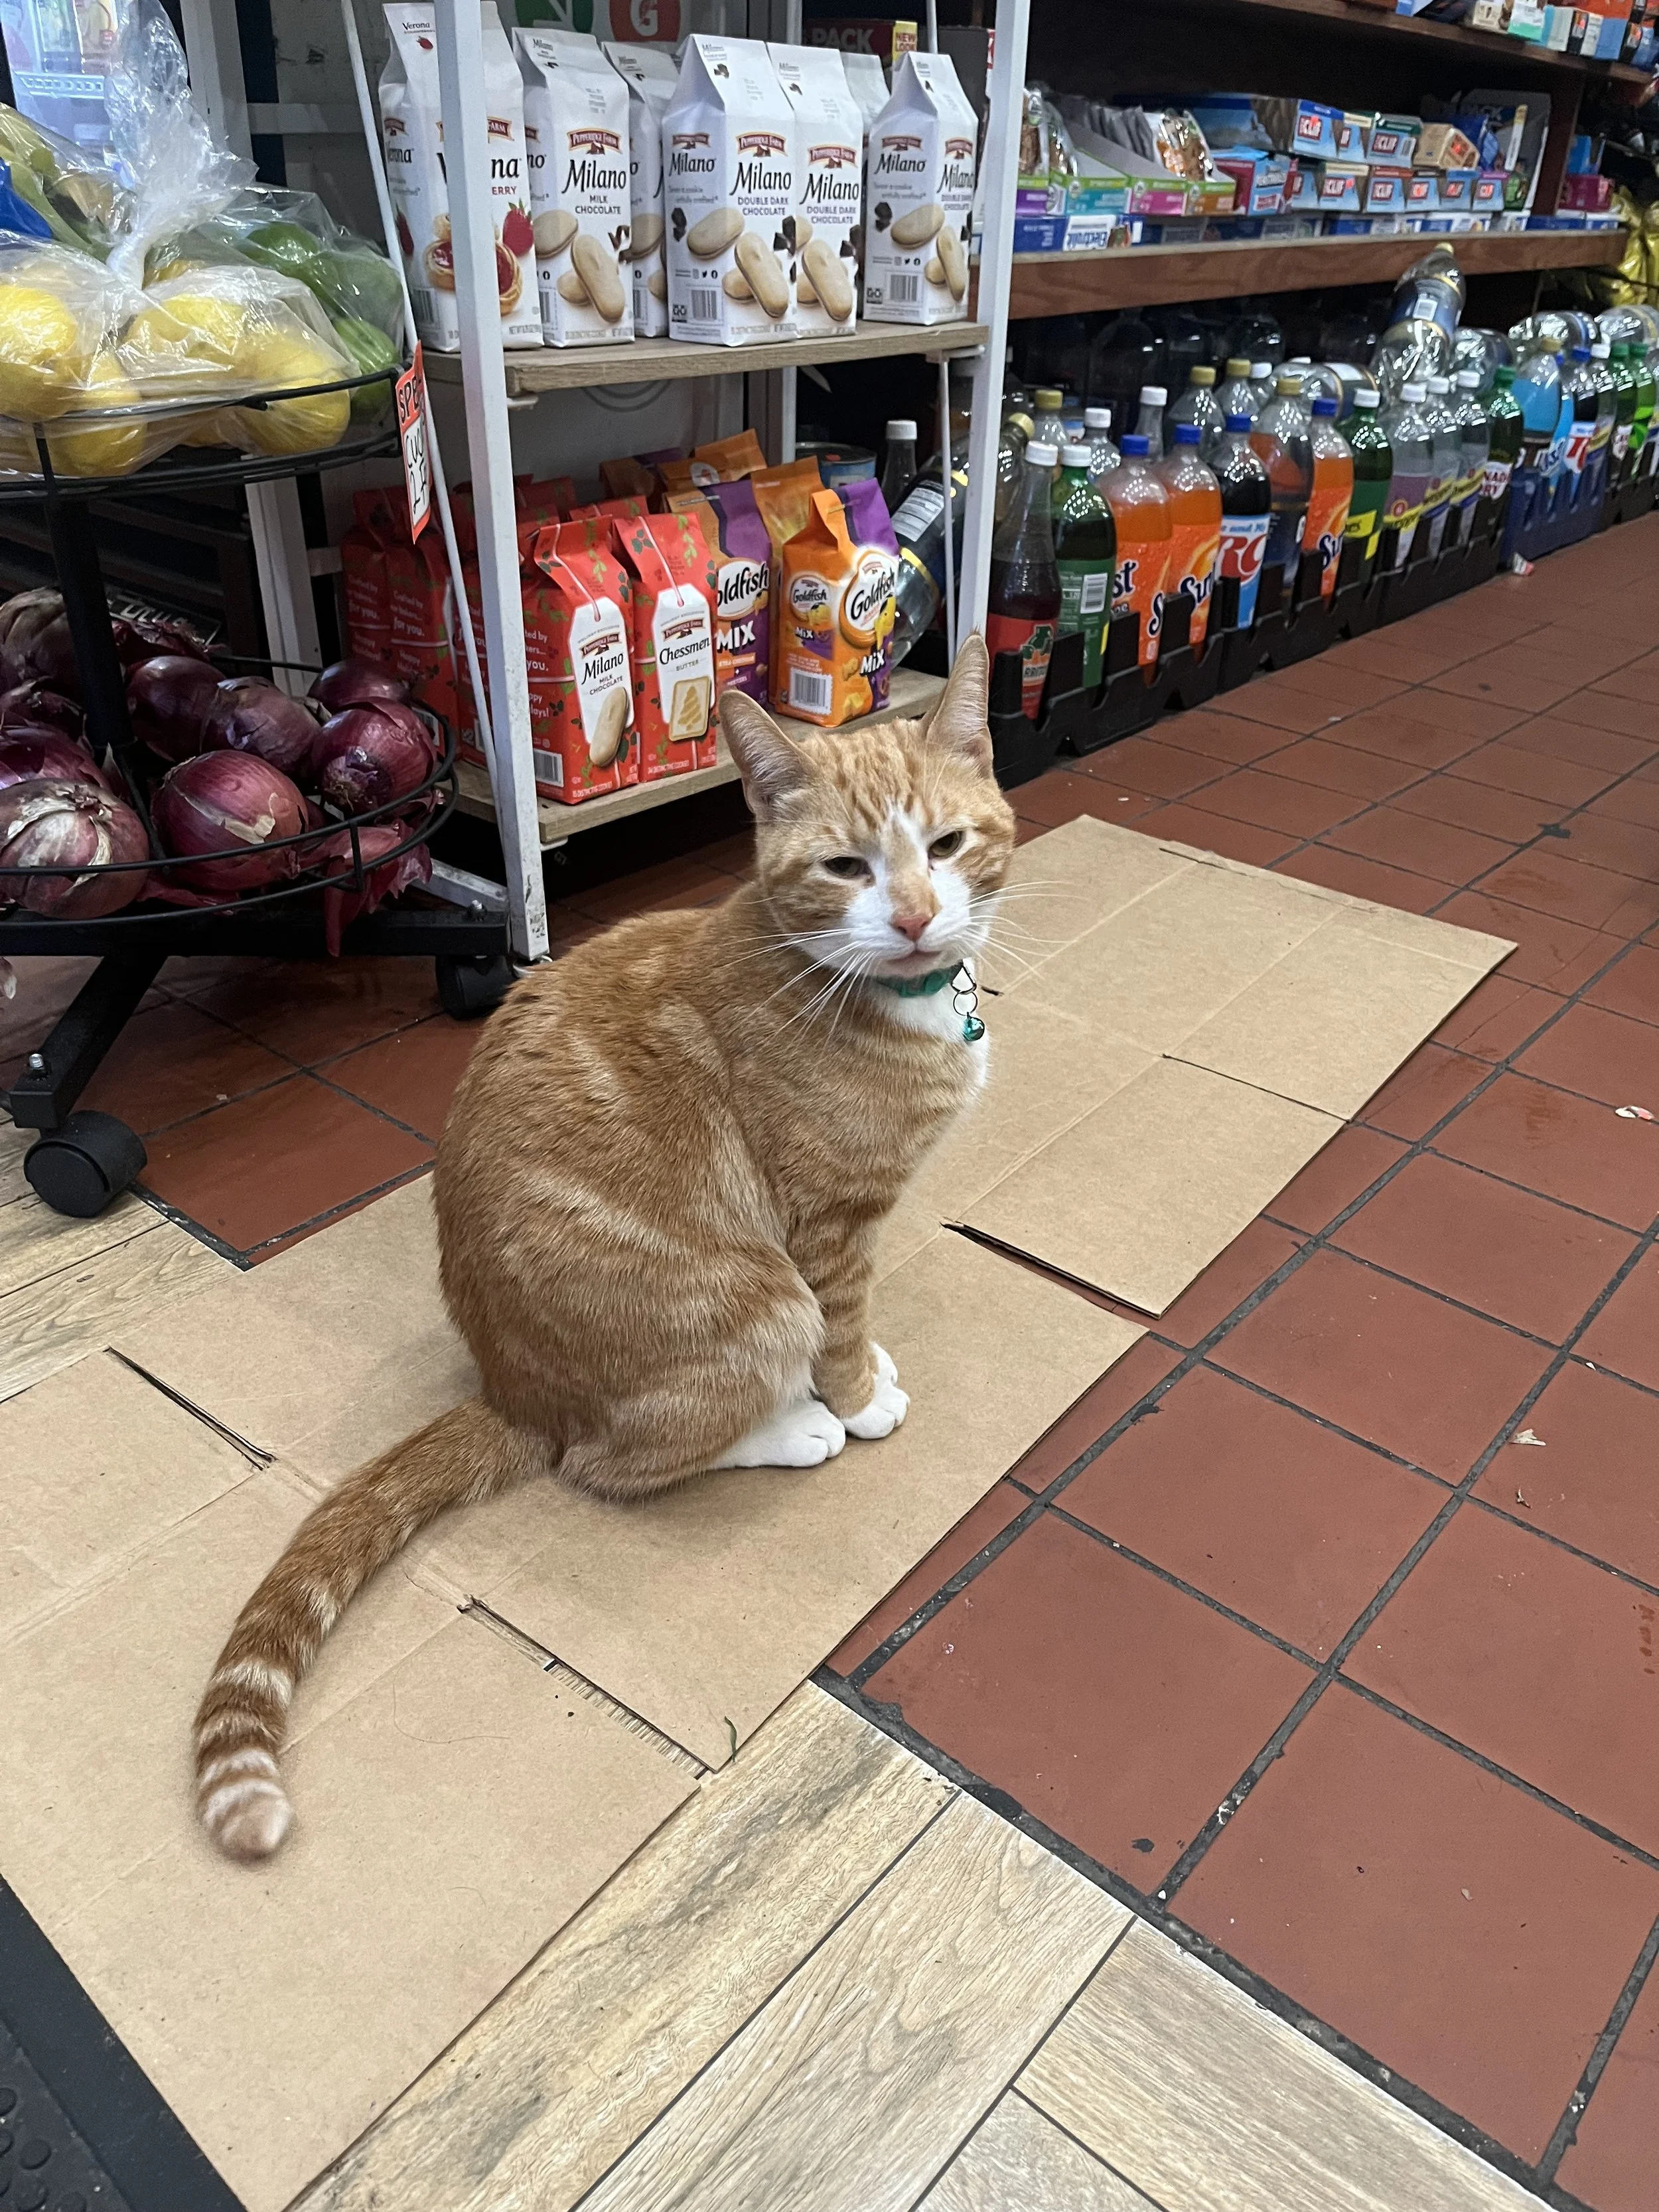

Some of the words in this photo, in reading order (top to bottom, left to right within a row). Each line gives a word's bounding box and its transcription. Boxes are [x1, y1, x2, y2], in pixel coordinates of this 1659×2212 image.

[402, 22, 430, 31] Verona
[812, 27, 875, 54] PACK
[668, 153, 715, 177] Milano
[874, 153, 926, 175] Milano
[561, 159, 626, 194] Milano
[729, 162, 792, 196] Milano
[800, 173, 859, 205] Milano
[589, 195, 608, 204] MILK
[738, 197, 768, 206] DOUBLE
[770, 196, 788, 205] DARK
[575, 205, 622, 215] CHOCOLATE
[742, 207, 786, 216] CHOCOLATE
[807, 206, 837, 215] DOUBLE
[811, 216, 853, 224] CHOCOLATE
[1220, 533, 1267, 579] RC
[794, 589, 828, 604] Goldfish
[538, 630, 548, 643] by
[659, 637, 711, 665] Chessmen
[581, 653, 624, 685] Milano
[676, 659, 699, 672] BUTTER
[589, 676, 623, 696] CHOCOLATE
[599, 674, 613, 684] MILK
